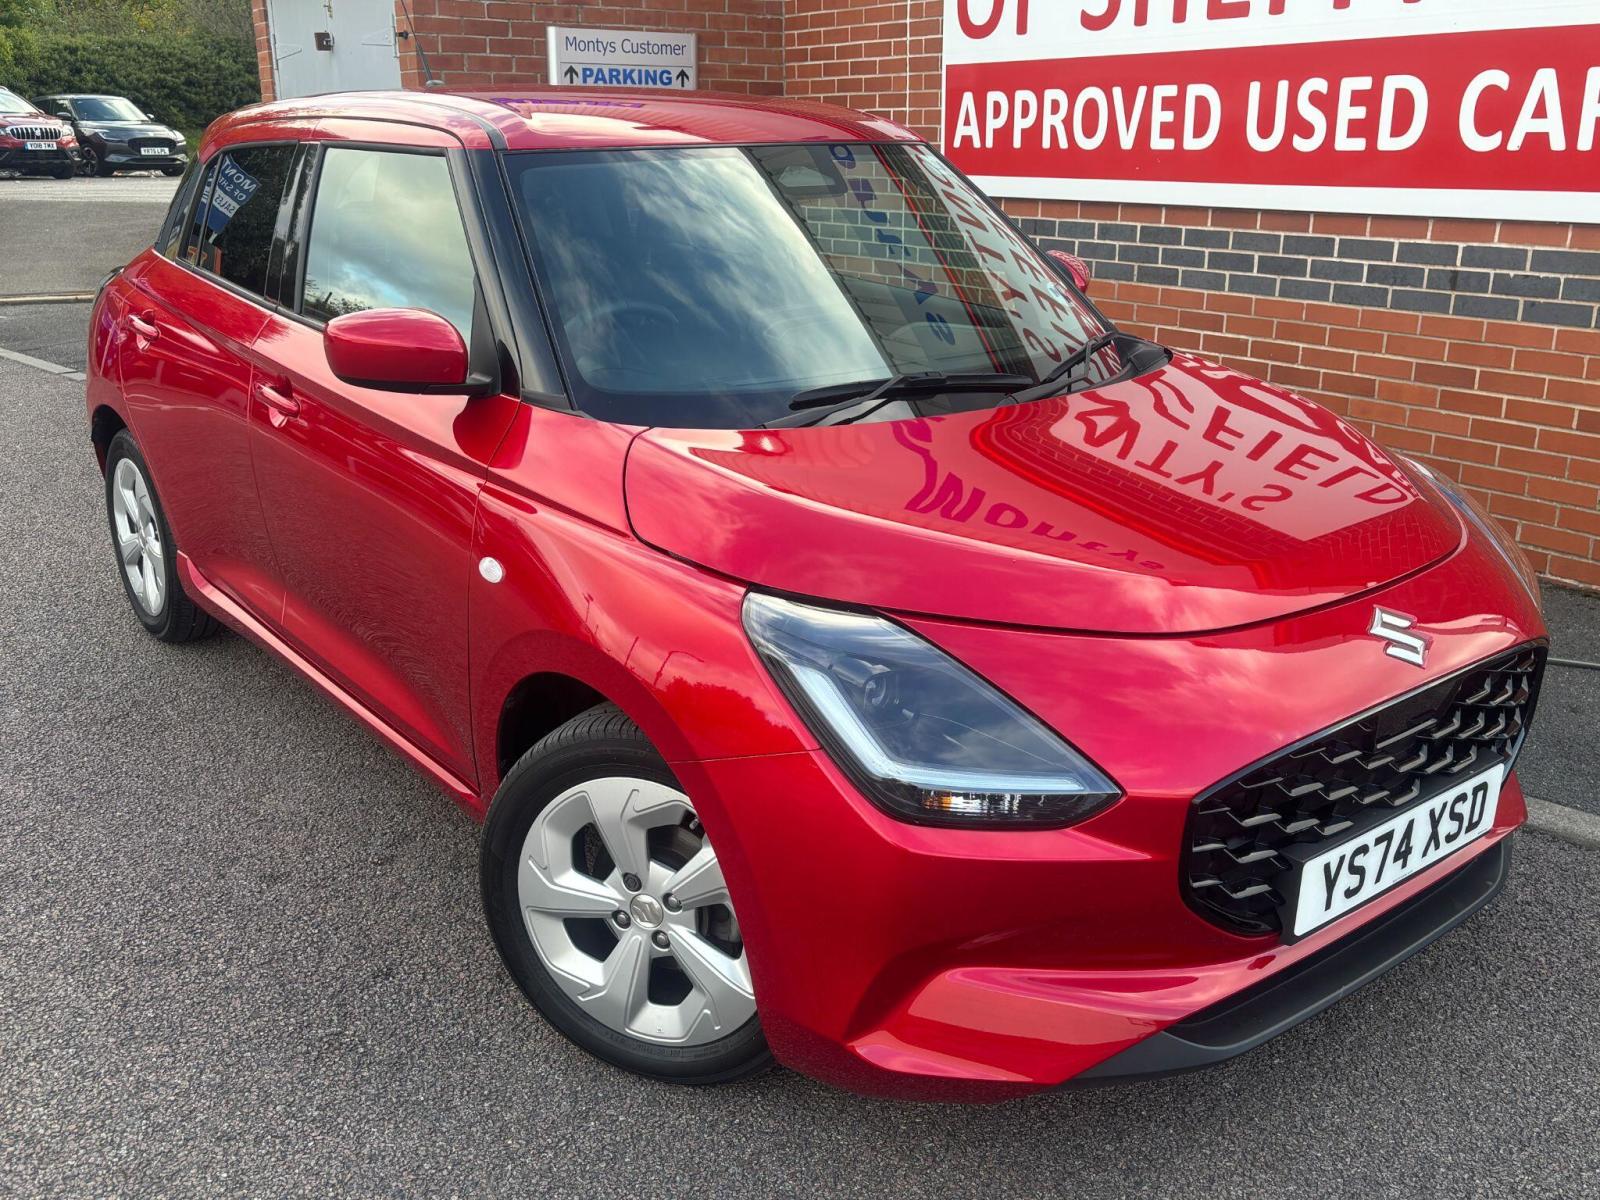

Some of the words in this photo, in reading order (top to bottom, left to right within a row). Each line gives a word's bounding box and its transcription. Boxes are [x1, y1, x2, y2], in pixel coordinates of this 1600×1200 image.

[565, 36, 617, 56] Montys
[621, 38, 687, 56] Customer
[582, 67, 673, 86] PARKING
[952, 82, 1222, 152] APPROVED
[1245, 74, 1429, 153] USED
[1323, 818, 1415, 912] YS74
[1421, 781, 1489, 859] XSD
